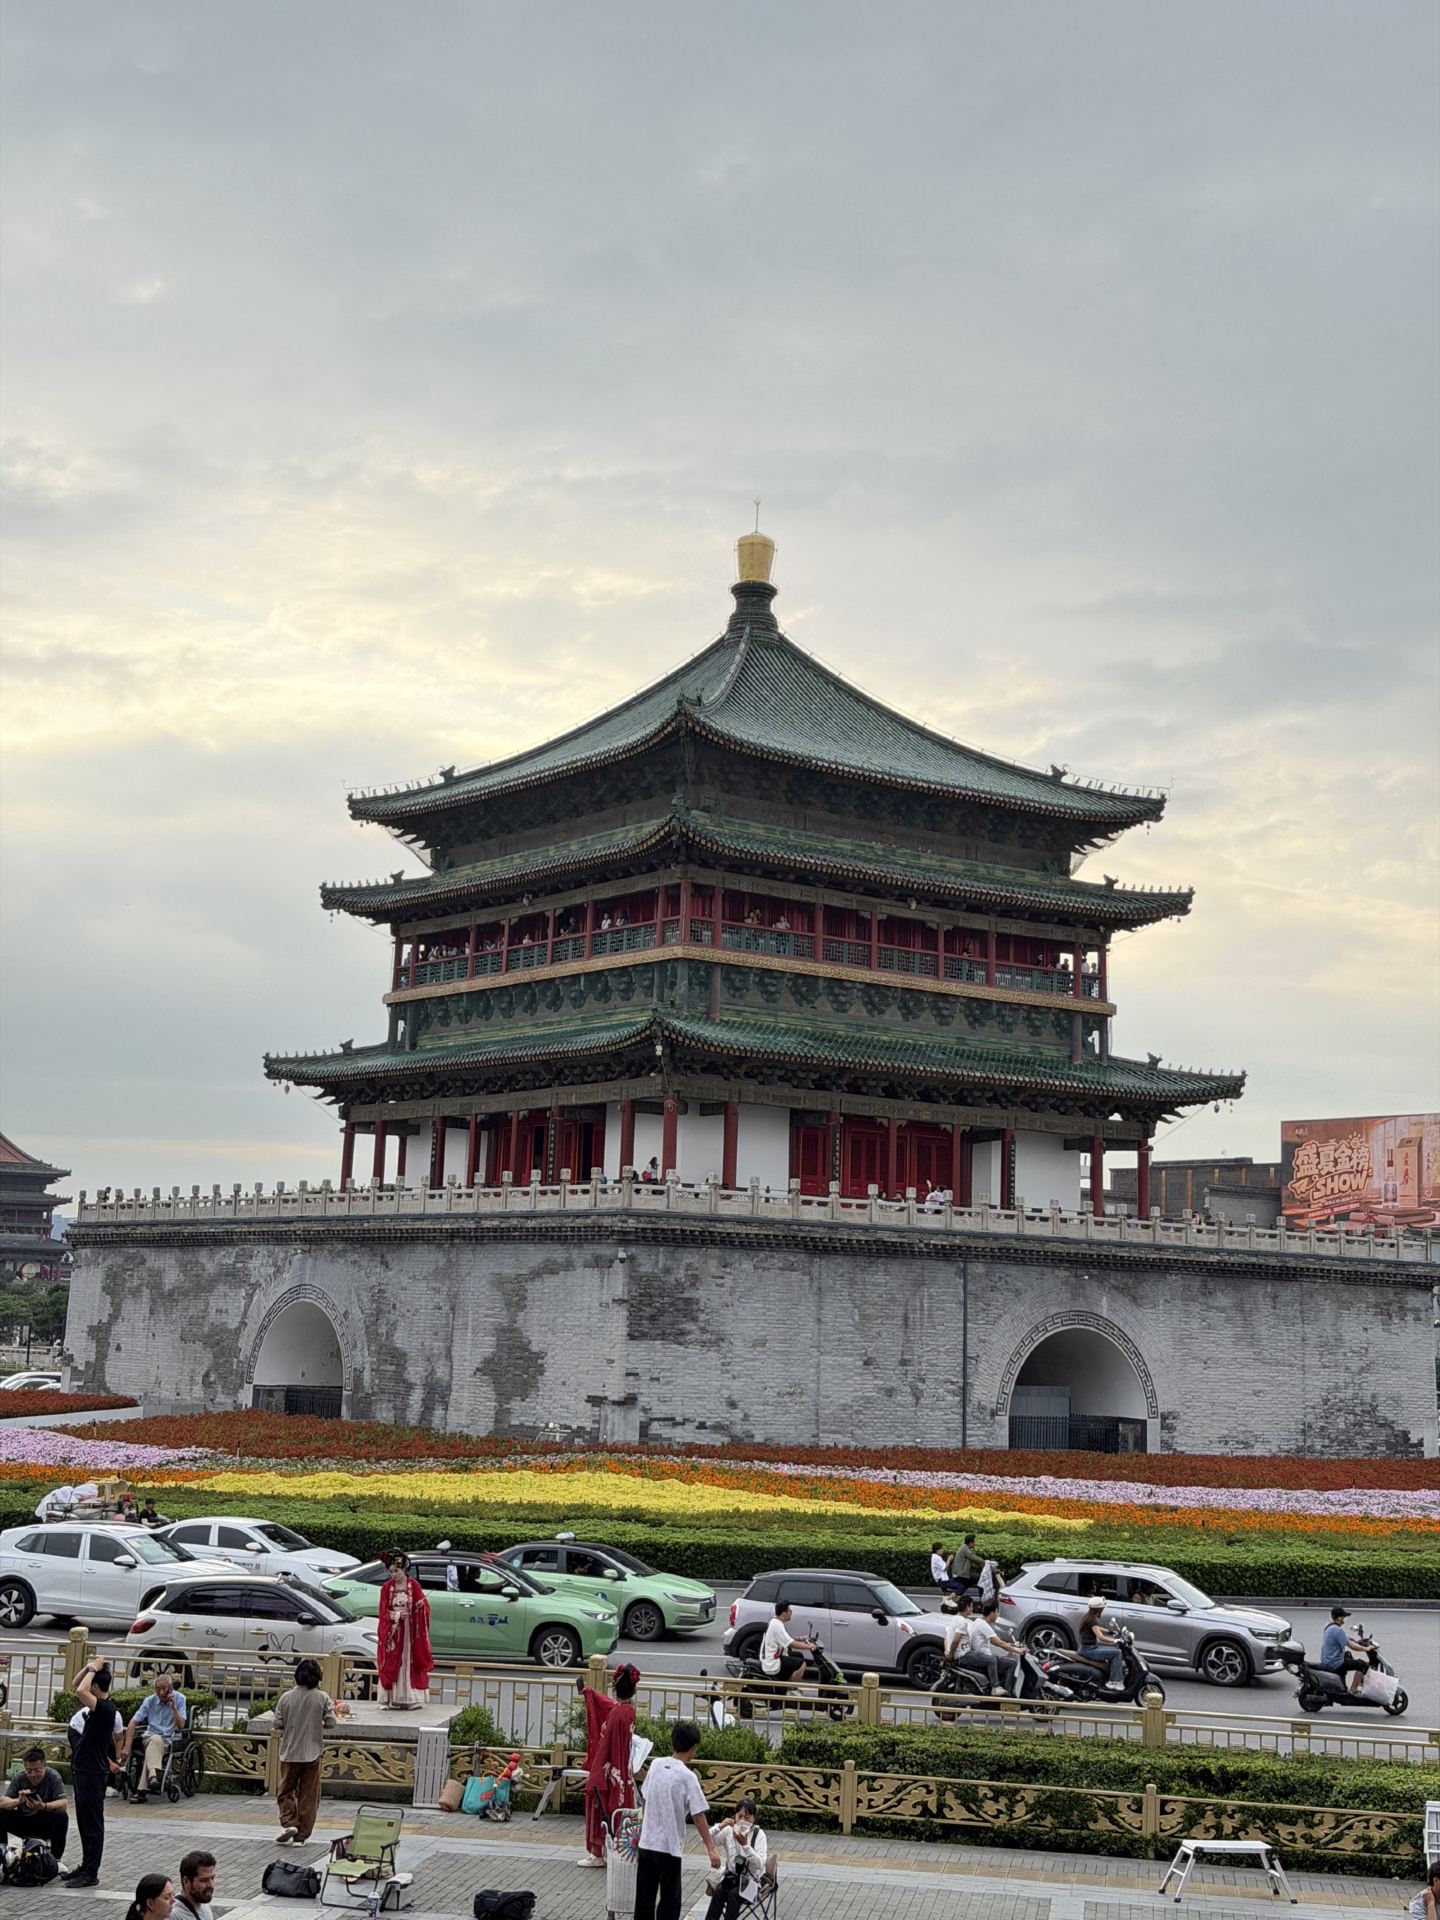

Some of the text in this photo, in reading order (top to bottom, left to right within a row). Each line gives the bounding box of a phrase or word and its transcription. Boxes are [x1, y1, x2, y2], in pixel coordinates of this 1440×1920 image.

[1296, 1140, 1369, 1178] 盛夏金榜
[1313, 1170, 1367, 1199] SHOW
